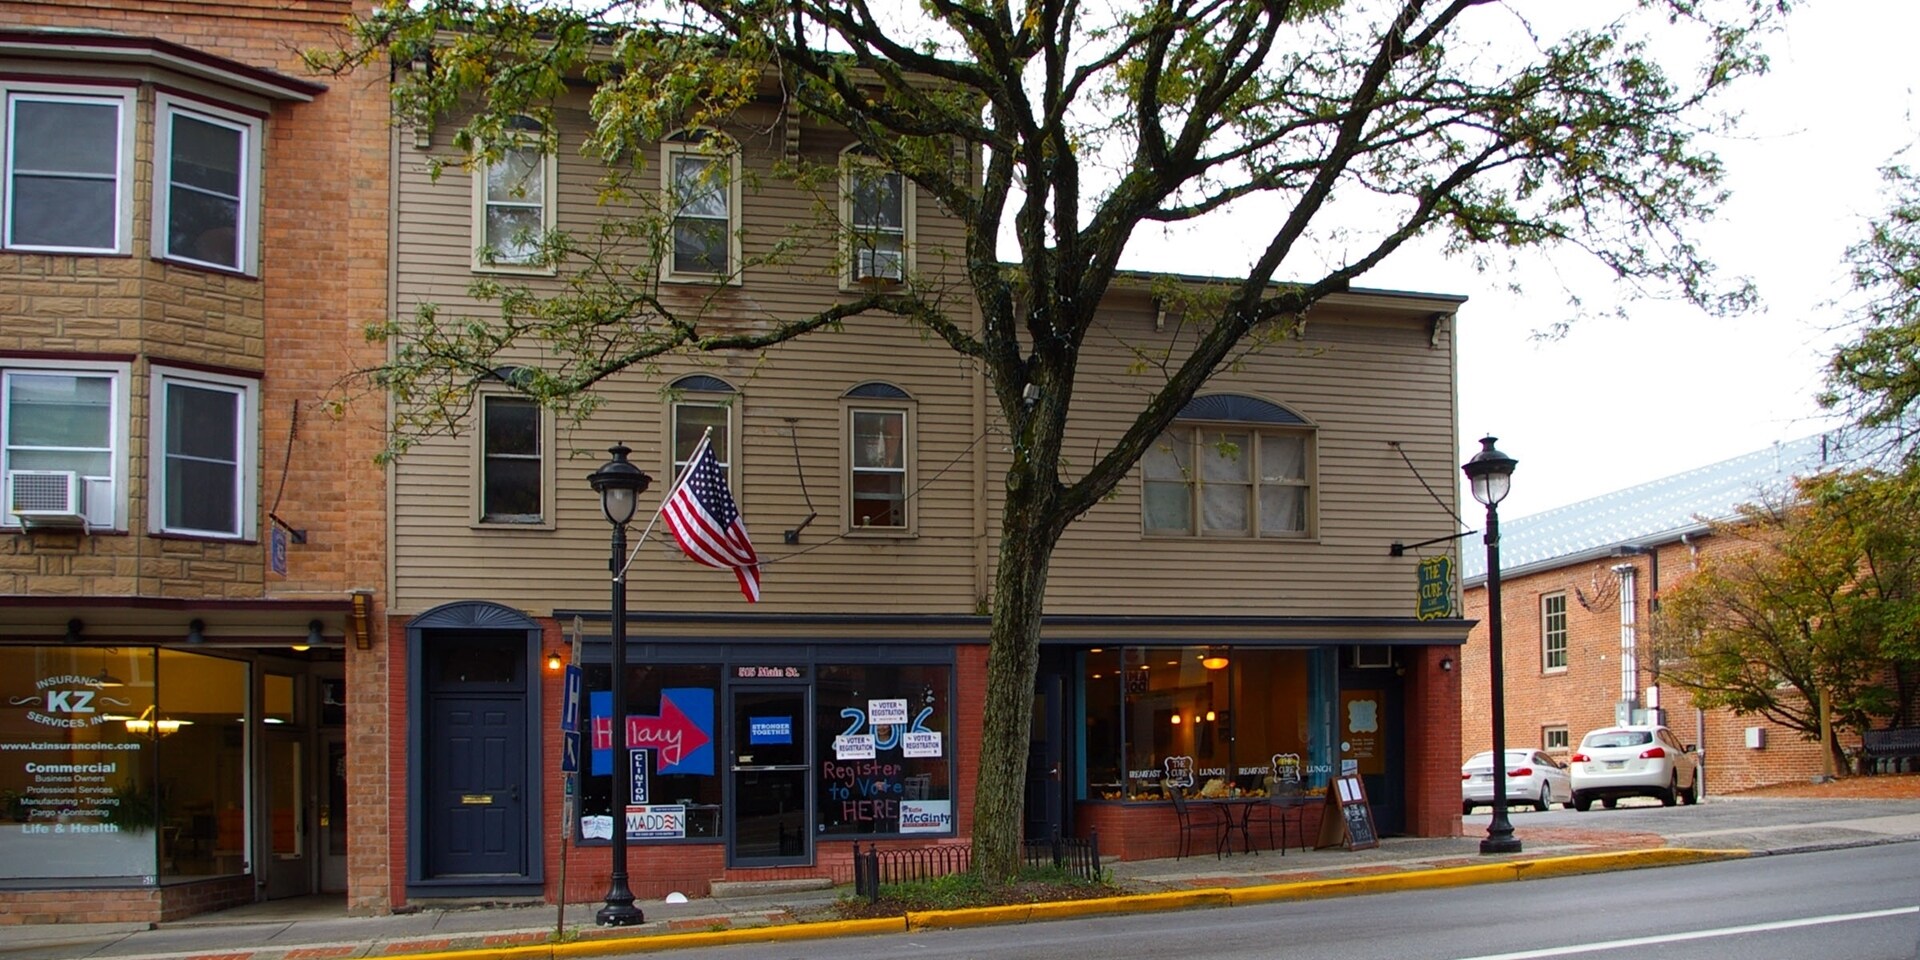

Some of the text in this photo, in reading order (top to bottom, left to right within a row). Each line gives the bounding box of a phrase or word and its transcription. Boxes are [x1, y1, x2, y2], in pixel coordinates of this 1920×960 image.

[1424, 564, 1440, 580] THE
[1422, 582, 1443, 599] CURE
[757, 667, 784, 677] Main
[785, 667, 800, 677] St.
[36, 675, 104, 690] INSURANCE
[47, 690, 96, 713] KZ
[567, 672, 580, 724] H
[597, 715, 682, 765] Hllary
[0, 742, 140, 750] www.kzinsuranceinc.com
[839, 744, 873, 752] REGISTRATION
[25, 762, 116, 773] Commercial
[1172, 760, 1186, 768] THE
[824, 760, 901, 788] Register
[1129, 769, 1161, 778] BREAKFAST
[1171, 769, 1188, 777] CURE
[1199, 768, 1226, 776] LUNCH
[1238, 766, 1270, 775] BREAKFAST
[635, 754, 645, 801] CLINTON
[27, 786, 113, 794] Professional Services
[828, 777, 904, 800] to Vote
[20, 797, 119, 806] Manufacturing Trucking
[30, 808, 109, 817] Cargo Contracting
[842, 800, 898, 821] HERE
[903, 812, 950, 824] McGinty
[22, 822, 119, 834] Life & Health
